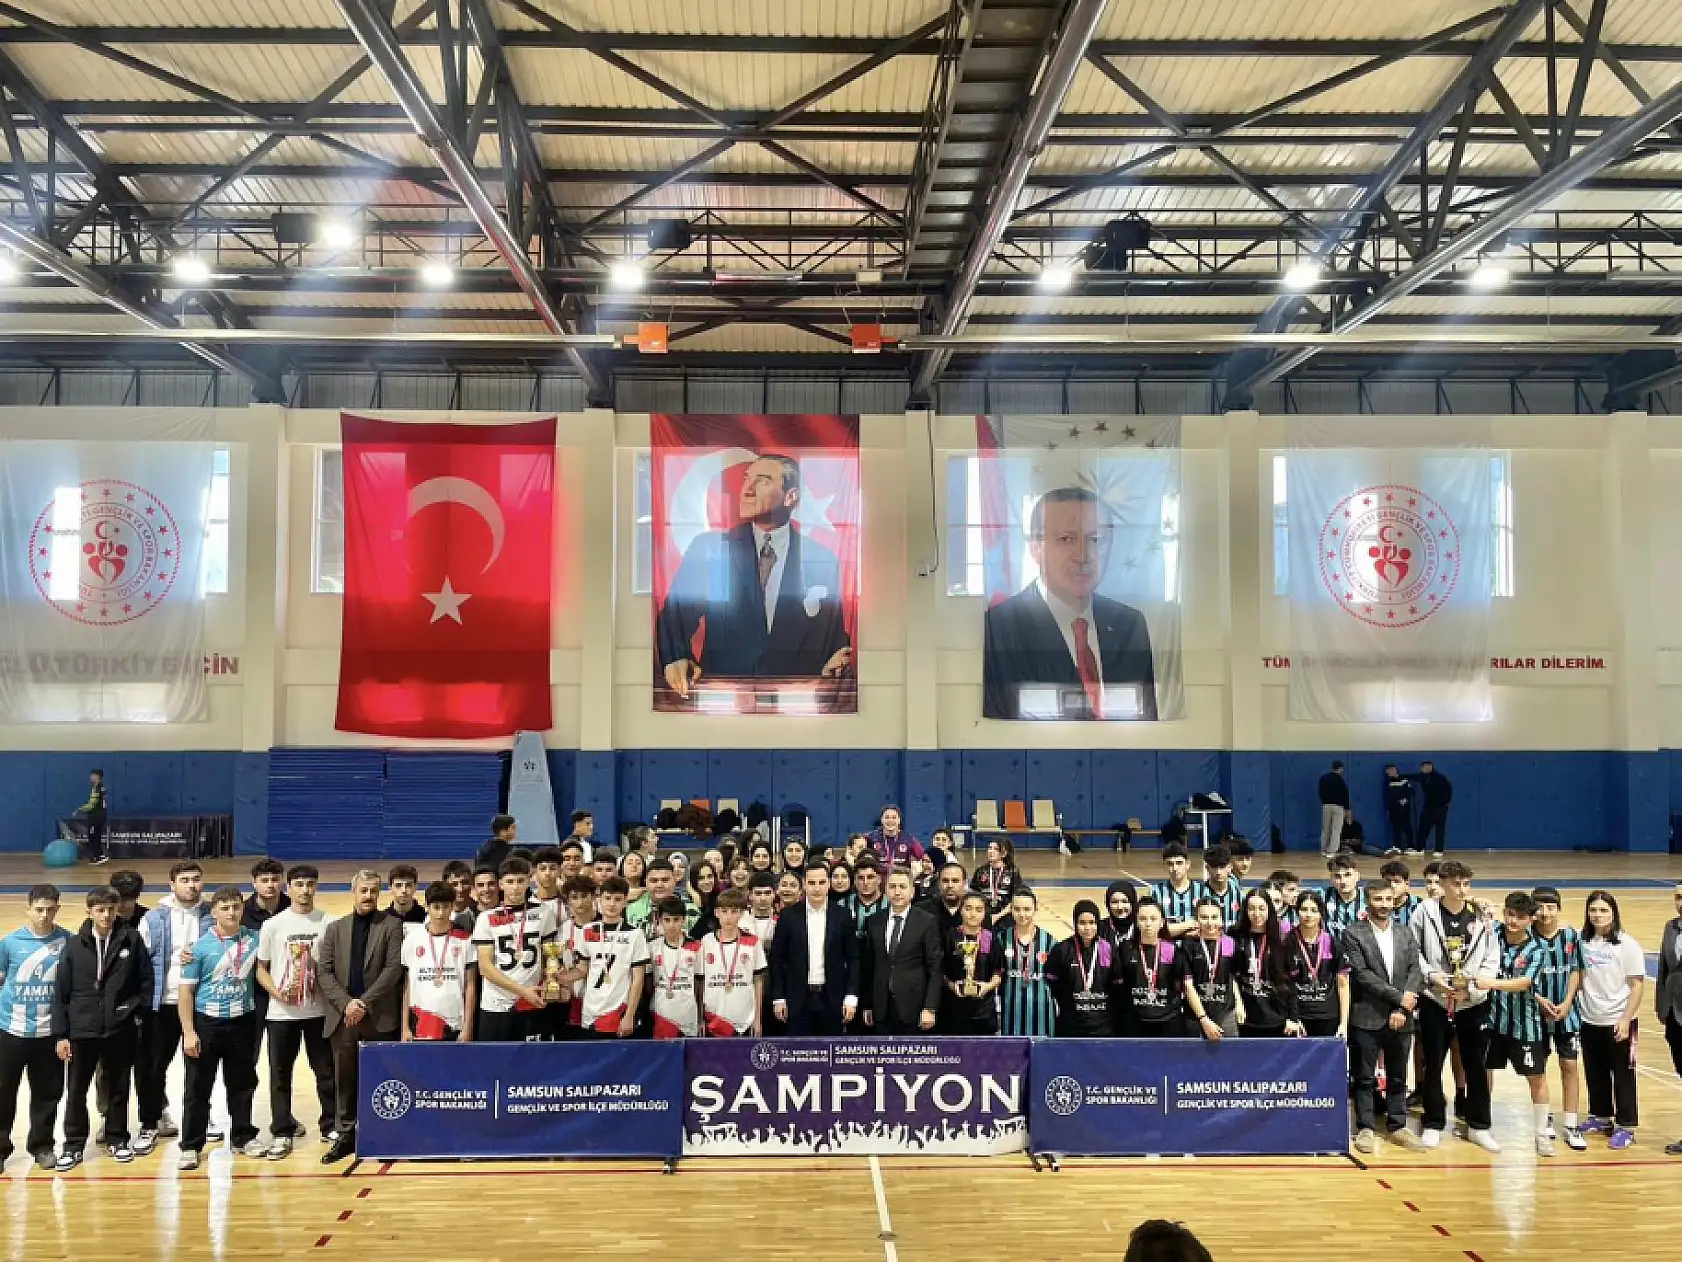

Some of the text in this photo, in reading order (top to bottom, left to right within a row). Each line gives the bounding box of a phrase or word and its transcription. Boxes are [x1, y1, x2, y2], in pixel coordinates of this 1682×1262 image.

[497, 931, 538, 971] 55
[593, 952, 616, 989] 7
[835, 1045, 878, 1055] SAMSUN
[507, 1084, 641, 1099] SAMSUN SALIPAZARI
[690, 1066, 1021, 1123] ŞAMPİYON
[1176, 1081, 1307, 1094] SAMSUN SALIPAZARI
[507, 1102, 547, 1115] GENÇLİK
[548, 1103, 560, 1113] VE
[562, 1103, 587, 1112] SPOR
[1177, 1098, 1215, 1111] GENÇLİK
[1216, 1099, 1228, 1109] VE
[1230, 1099, 1255, 1109] SPOR
